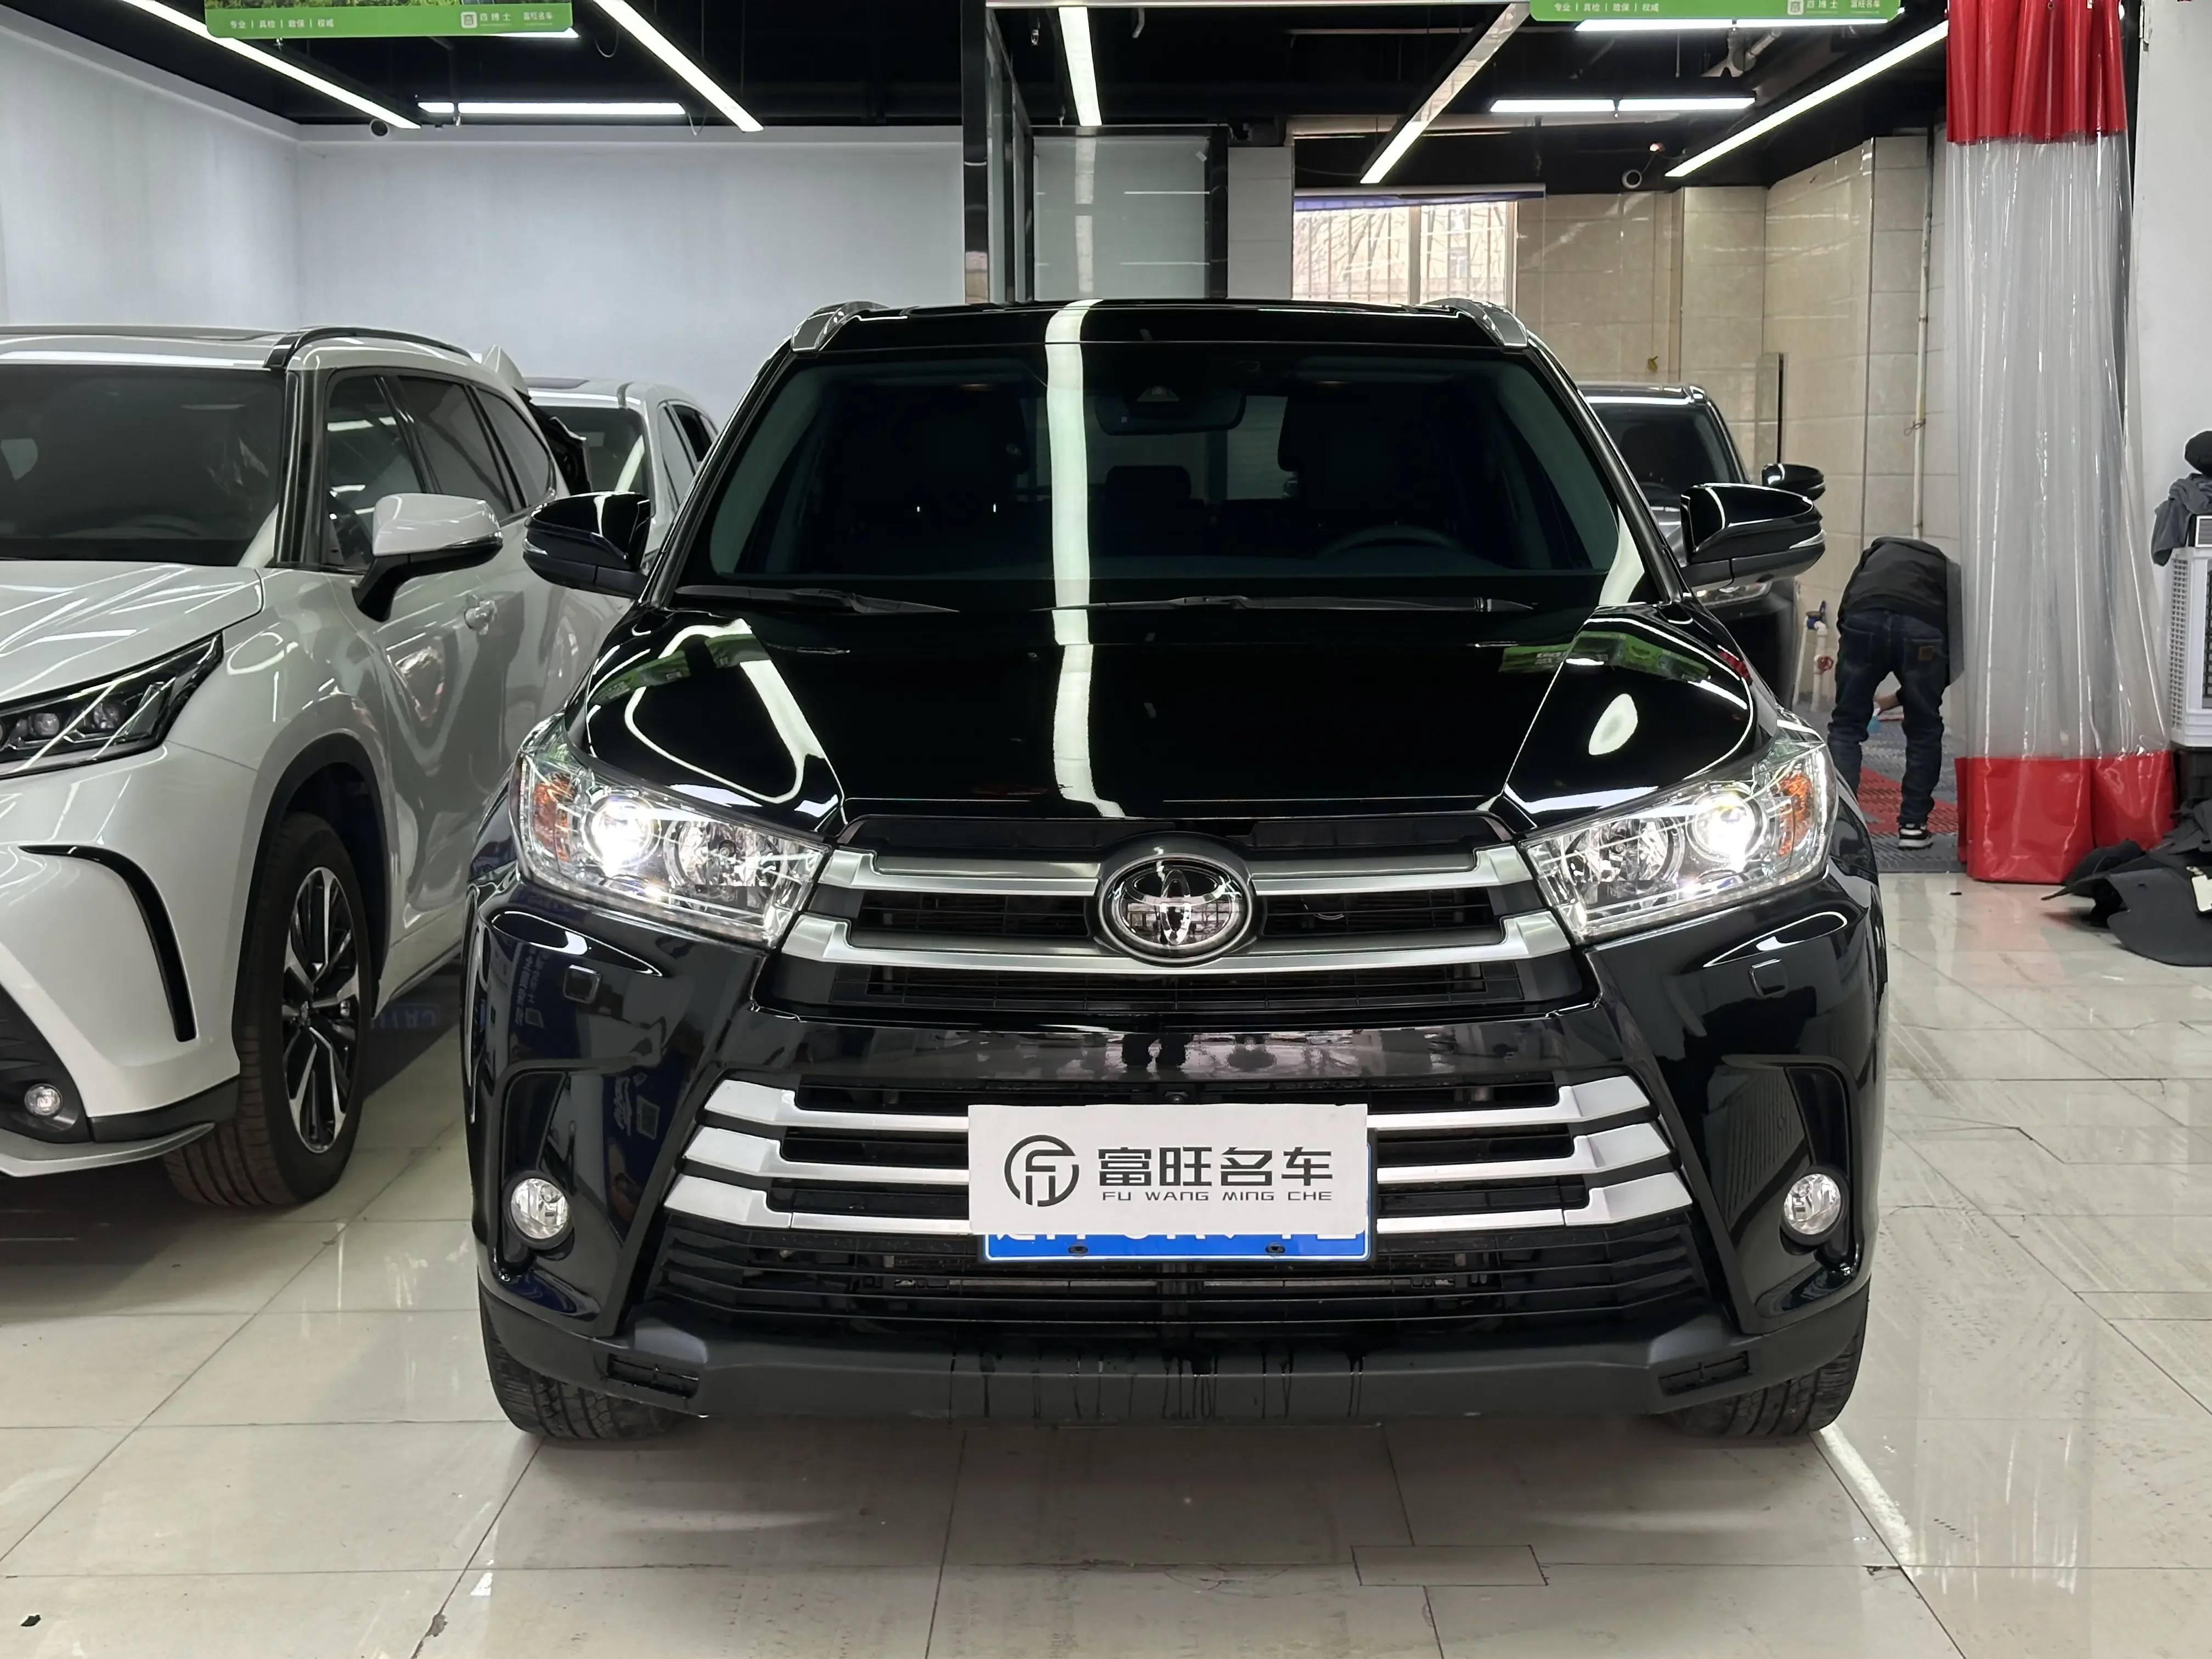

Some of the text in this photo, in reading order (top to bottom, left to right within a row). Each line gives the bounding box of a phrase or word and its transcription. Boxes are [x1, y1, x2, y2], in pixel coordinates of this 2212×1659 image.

[1554, 3, 1571, 12] 专业
[1642, 3, 1659, 12] 权威
[1098, 1147, 1333, 1186] 富旺名车
[1102, 1191, 1332, 1201] FU WANG MING CHE
